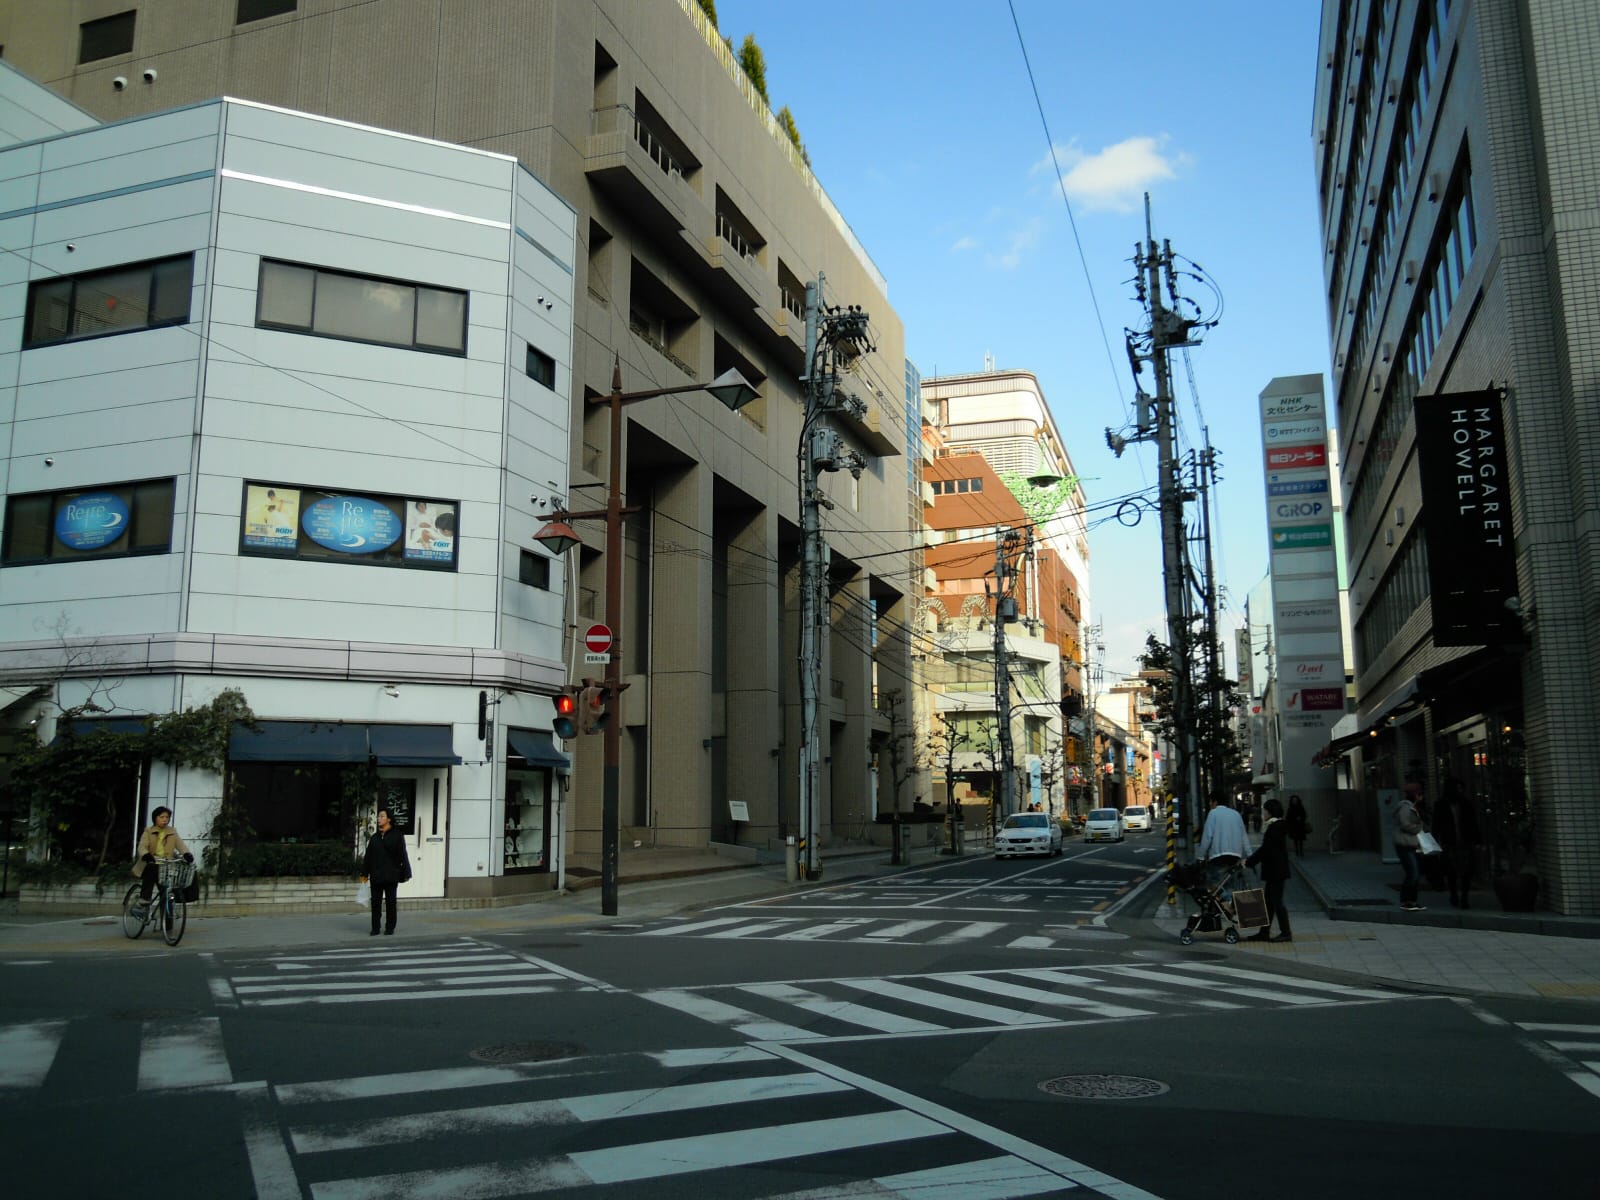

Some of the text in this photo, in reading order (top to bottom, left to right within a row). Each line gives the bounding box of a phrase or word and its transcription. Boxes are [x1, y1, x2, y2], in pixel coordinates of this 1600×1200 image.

[1266, 404, 1318, 415] 文化センター
[1280, 397, 1303, 405] NHK
[1451, 409, 1476, 515] HOWELL
[1474, 407, 1502, 546] MARGARET
